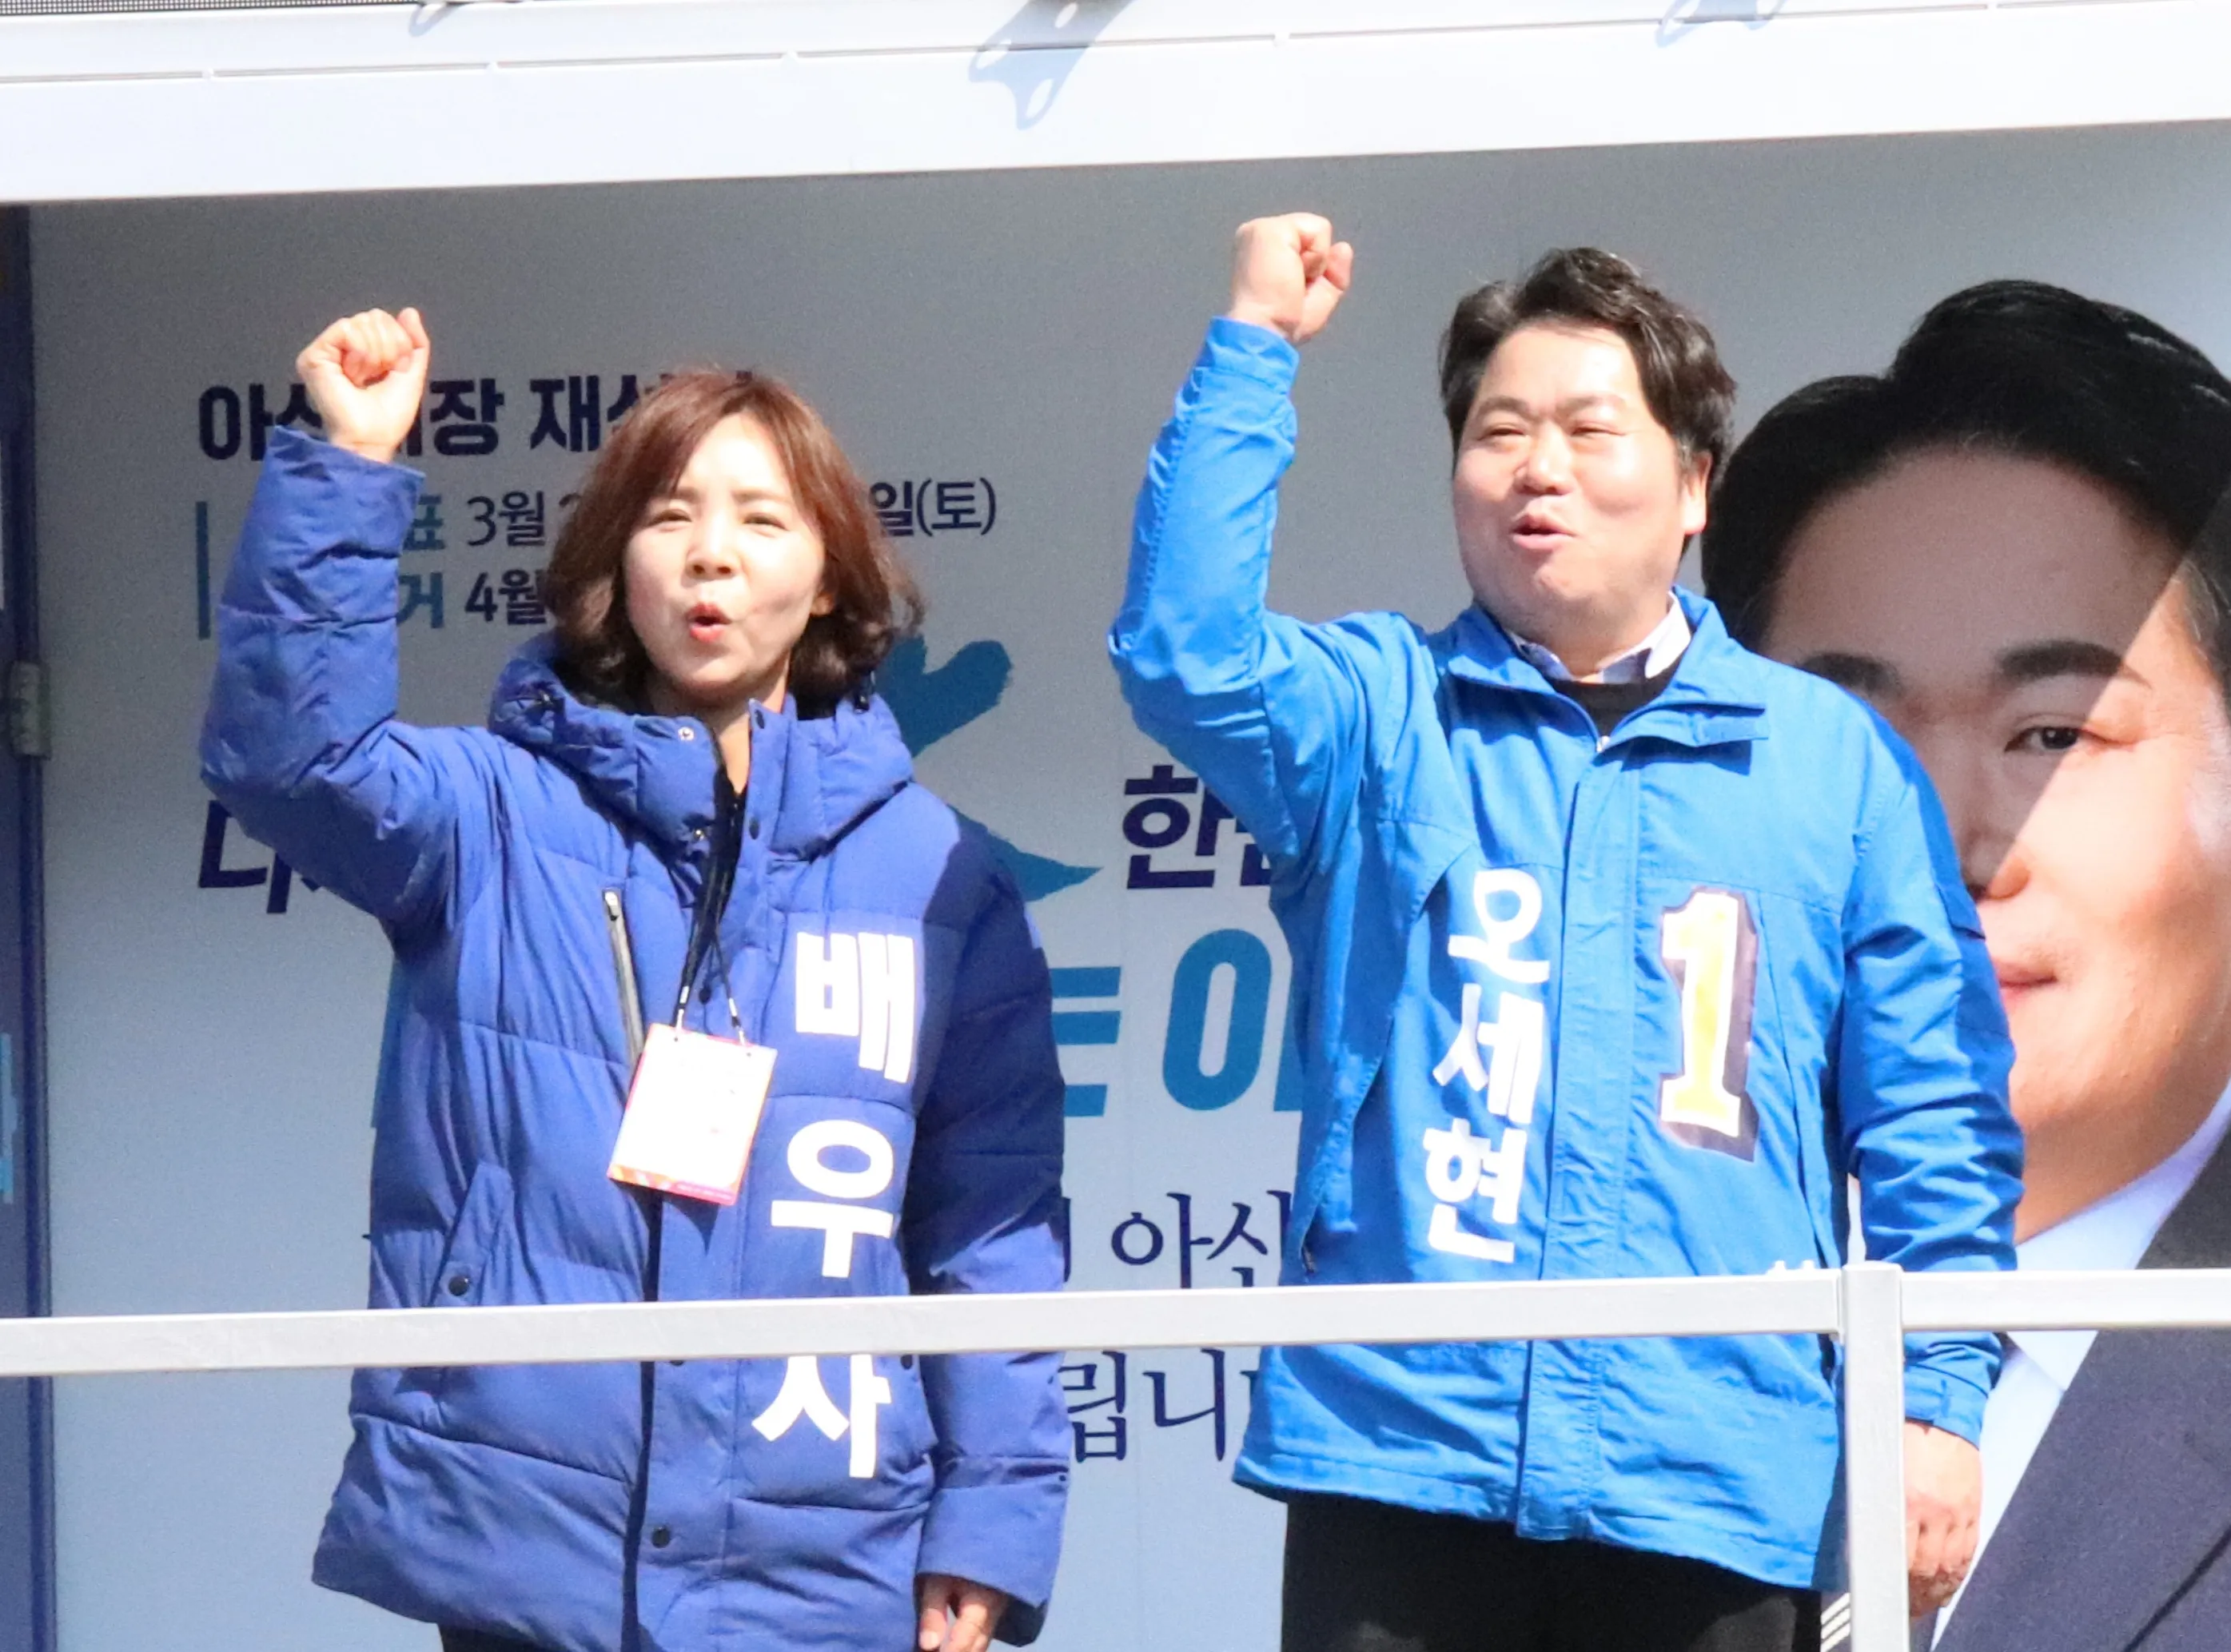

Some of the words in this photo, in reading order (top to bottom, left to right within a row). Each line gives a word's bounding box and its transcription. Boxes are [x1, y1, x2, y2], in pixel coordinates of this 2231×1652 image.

[200, 376, 504, 461] 아장
[466, 491, 546, 547] 3월
[870, 477, 997, 537] 일(토)
[464, 568, 548, 626] 4월
[1423, 867, 1550, 1263] 오세현
[1659, 889, 1747, 1149] 1
[1057, 1348, 1258, 1463] 립니
